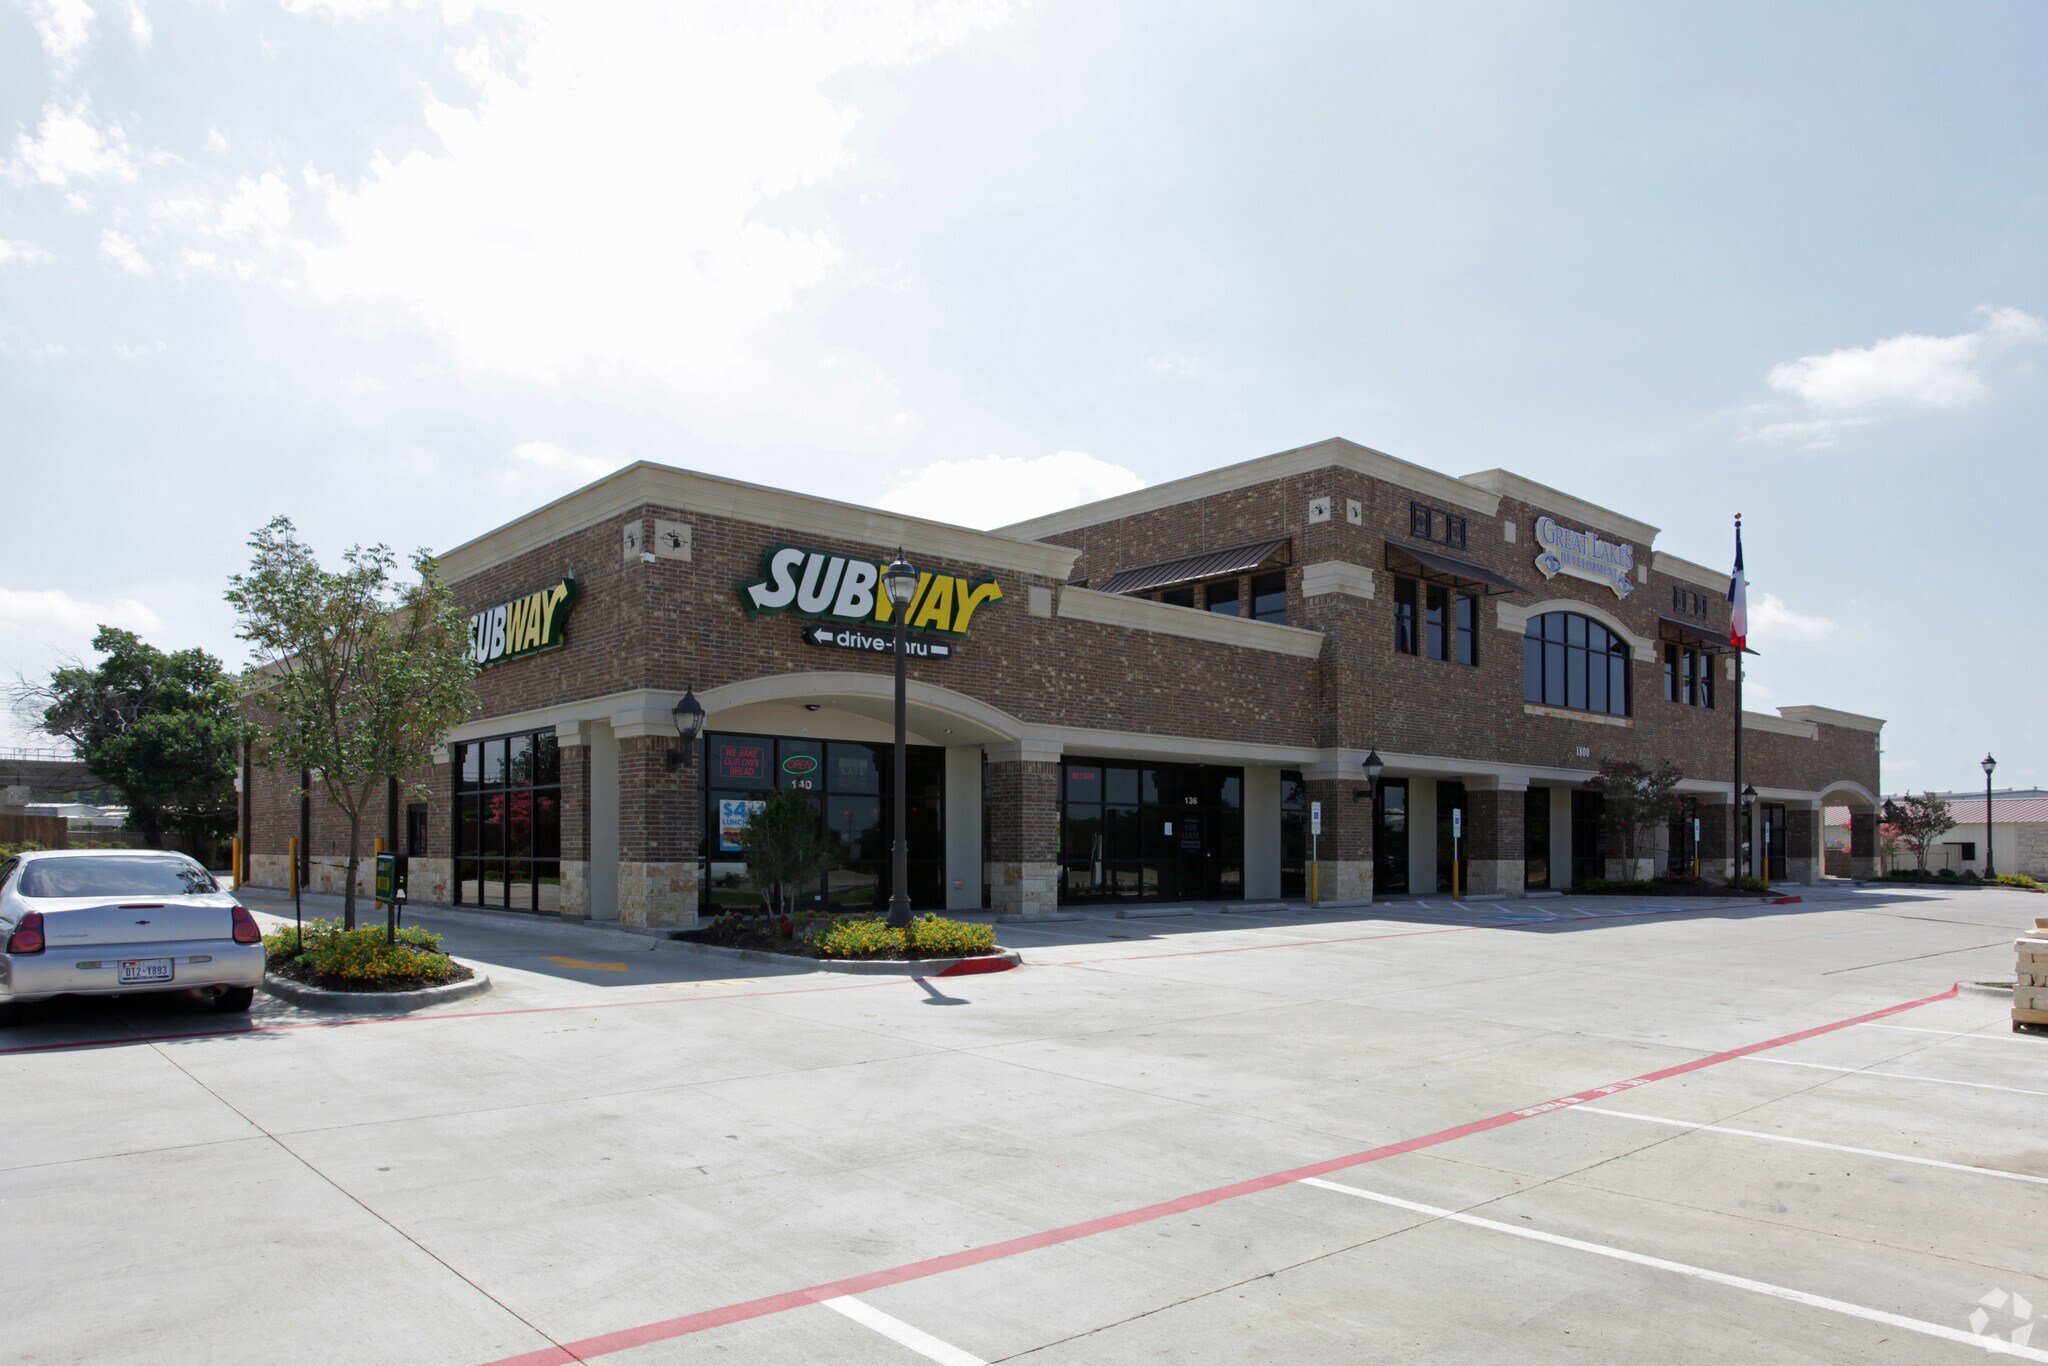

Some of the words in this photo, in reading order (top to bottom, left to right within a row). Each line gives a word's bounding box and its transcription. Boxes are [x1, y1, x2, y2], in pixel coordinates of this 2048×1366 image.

[1560, 551, 1618, 577] DEVELOPMENT
[748, 548, 1003, 633] SUBWAY
[462, 579, 568, 664] SUBWAY
[726, 747, 736, 757] WE
[739, 748, 757, 758] BAKE
[724, 757, 740, 766] OUR
[742, 758, 759, 768] OWN
[786, 760, 813, 770] OPEN
[730, 767, 754, 776] BREAD
[791, 780, 812, 790] 140
[1184, 797, 1198, 805] 136
